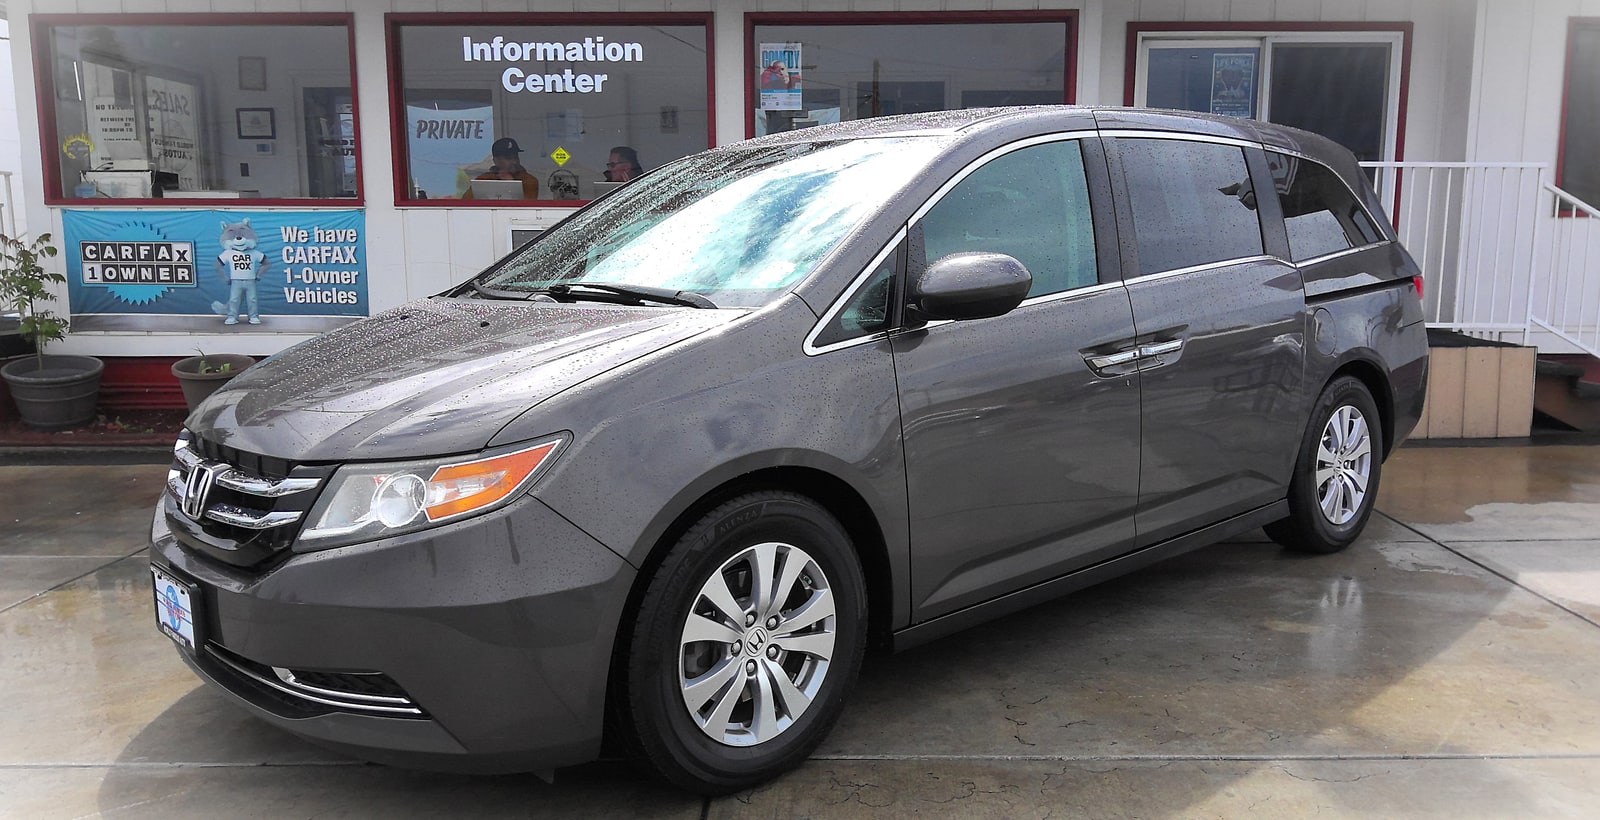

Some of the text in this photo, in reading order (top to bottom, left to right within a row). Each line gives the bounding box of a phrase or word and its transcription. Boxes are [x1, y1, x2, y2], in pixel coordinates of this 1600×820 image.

[462, 36, 643, 62] Information
[501, 67, 608, 93] Center
[416, 119, 485, 140] PRIVATE
[281, 226, 357, 243] We have
[85, 245, 191, 262] CARFAX
[232, 254, 251, 262] CAR
[282, 246, 357, 264] CARFAX
[88, 267, 190, 280] 1 OWNER
[234, 262, 251, 270] FOX
[284, 267, 358, 284] 1-Owner
[284, 287, 357, 304] Vehicles
[719, 510, 757, 534] ALENZA
